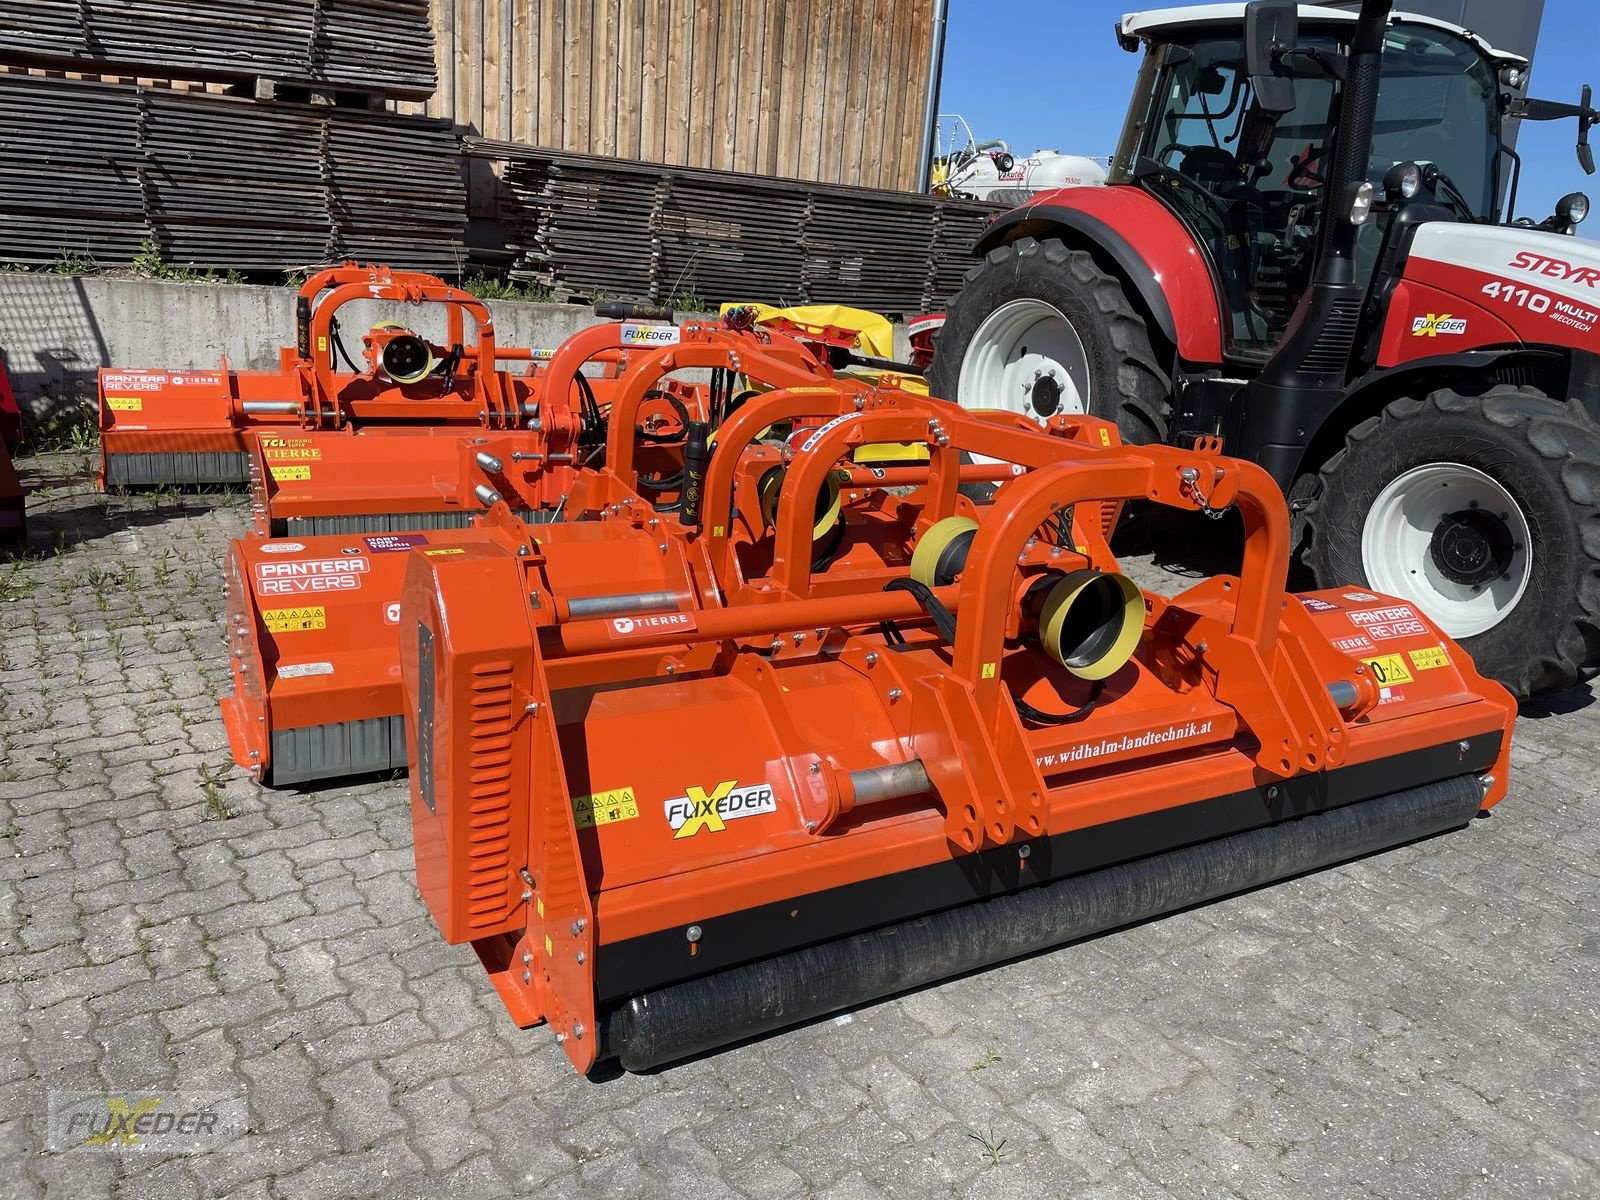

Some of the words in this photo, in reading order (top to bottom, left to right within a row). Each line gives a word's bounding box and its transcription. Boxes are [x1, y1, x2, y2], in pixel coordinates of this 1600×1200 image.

[1508, 251, 1600, 288] STEYR
[1481, 281, 1550, 314] 4110
[1554, 301, 1598, 323] MULTI
[1556, 314, 1592, 332] ECOTECH
[624, 330, 672, 341] FLIXEDER
[105, 375, 166, 383] PANTERA
[264, 448, 321, 458] TIERRE
[261, 559, 365, 577] PANTERA
[262, 575, 356, 593] REVERS
[634, 614, 688, 627] TIERRE
[1350, 607, 1414, 625] PANTERA
[1368, 620, 1425, 639] REVERS
[668, 789, 772, 823] FLIXEDER
